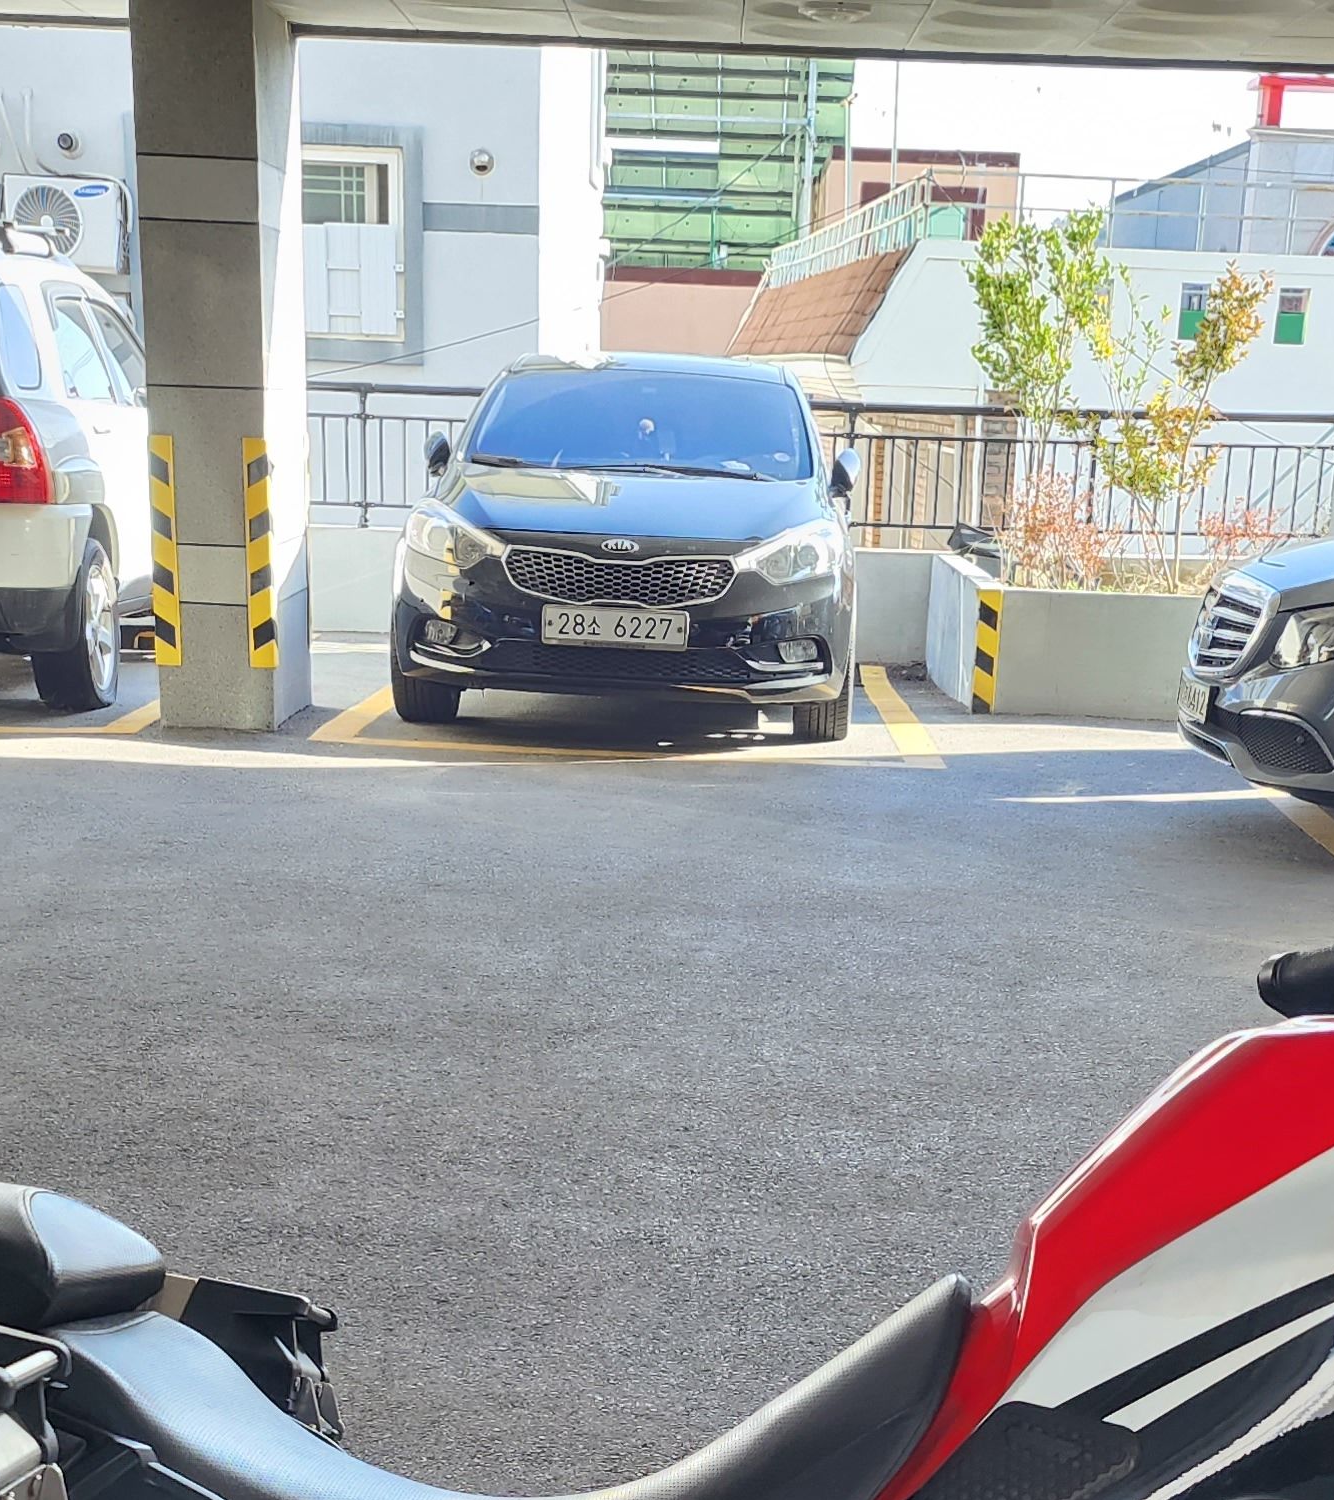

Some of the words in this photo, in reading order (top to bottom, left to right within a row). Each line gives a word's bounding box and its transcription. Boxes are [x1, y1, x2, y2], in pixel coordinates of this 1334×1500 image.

[606, 540, 633, 551] KIA
[558, 612, 602, 637] 28소
[614, 615, 673, 640] 6227
